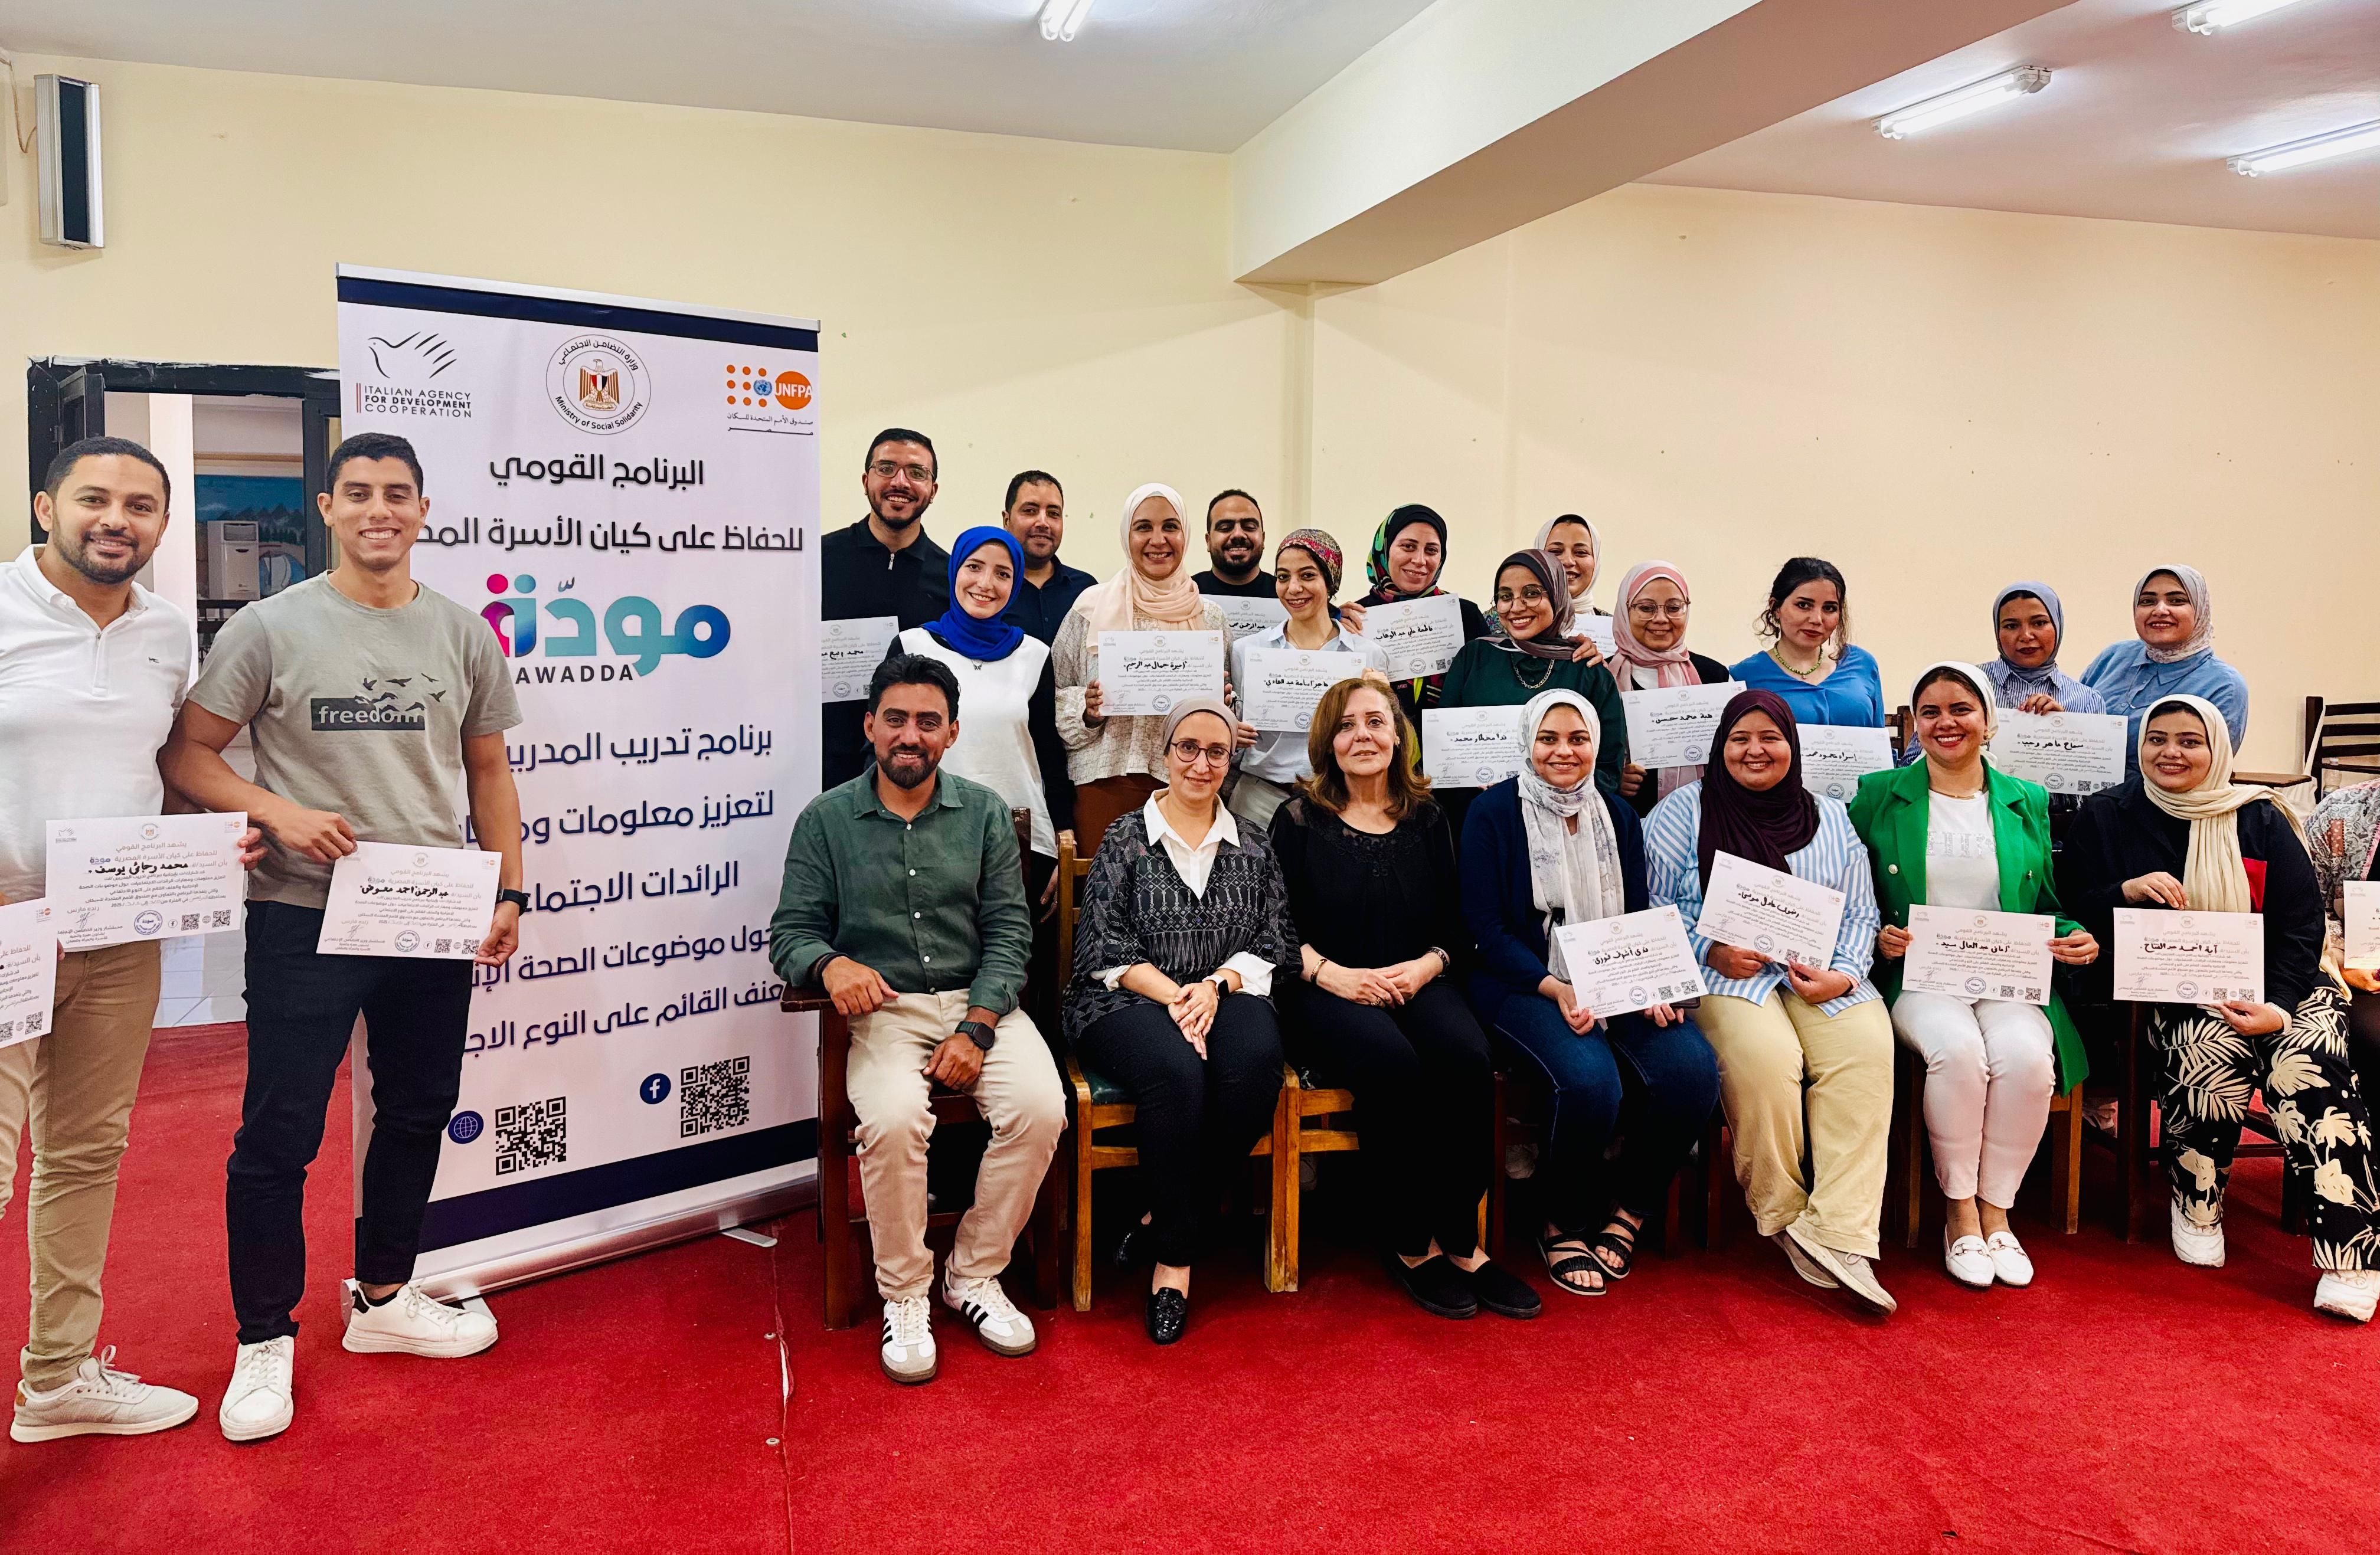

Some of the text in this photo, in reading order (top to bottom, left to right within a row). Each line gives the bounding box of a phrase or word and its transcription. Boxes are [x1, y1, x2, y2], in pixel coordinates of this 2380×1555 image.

[558, 339, 639, 371] وزارة التضامن الاجتماعي
[365, 385, 471, 401] ITALIAN AGENCY
[365, 395, 471, 409] FOR DEVELOPMENT
[774, 382, 812, 398] UNFPA
[365, 404, 472, 418] COOPERATION
[555, 396, 581, 424] Ministry
[591, 421, 614, 430] Social
[614, 401, 643, 427] Solidarity
[727, 412, 750, 420] للسكان
[774, 415, 789, 425] الأمم
[490, 453, 704, 490] البرنامج القومي
[488, 515, 581, 551] الأسرة
[590, 520, 650, 554] كيان
[658, 523, 715, 552] على
[721, 525, 803, 552] للحفاظ
[515, 664, 633, 685] AWADDA
[318, 705, 419, 724] freedom
[506, 724, 771, 773] برنامج تدريب المدربي
[559, 800, 694, 836] معلومات
[699, 790, 773, 829] لتعزيز
[95, 865, 125, 876] يوسف
[523, 860, 738, 912] الرائدات الاجتماع
[518, 947, 595, 981] الصحة
[603, 934, 725, 968] موضوعات
[656, 986, 727, 1027] القائم
[734, 980, 784, 1006] عنف
[523, 1010, 586, 1050] النوع
[593, 1002, 649, 1034] على
